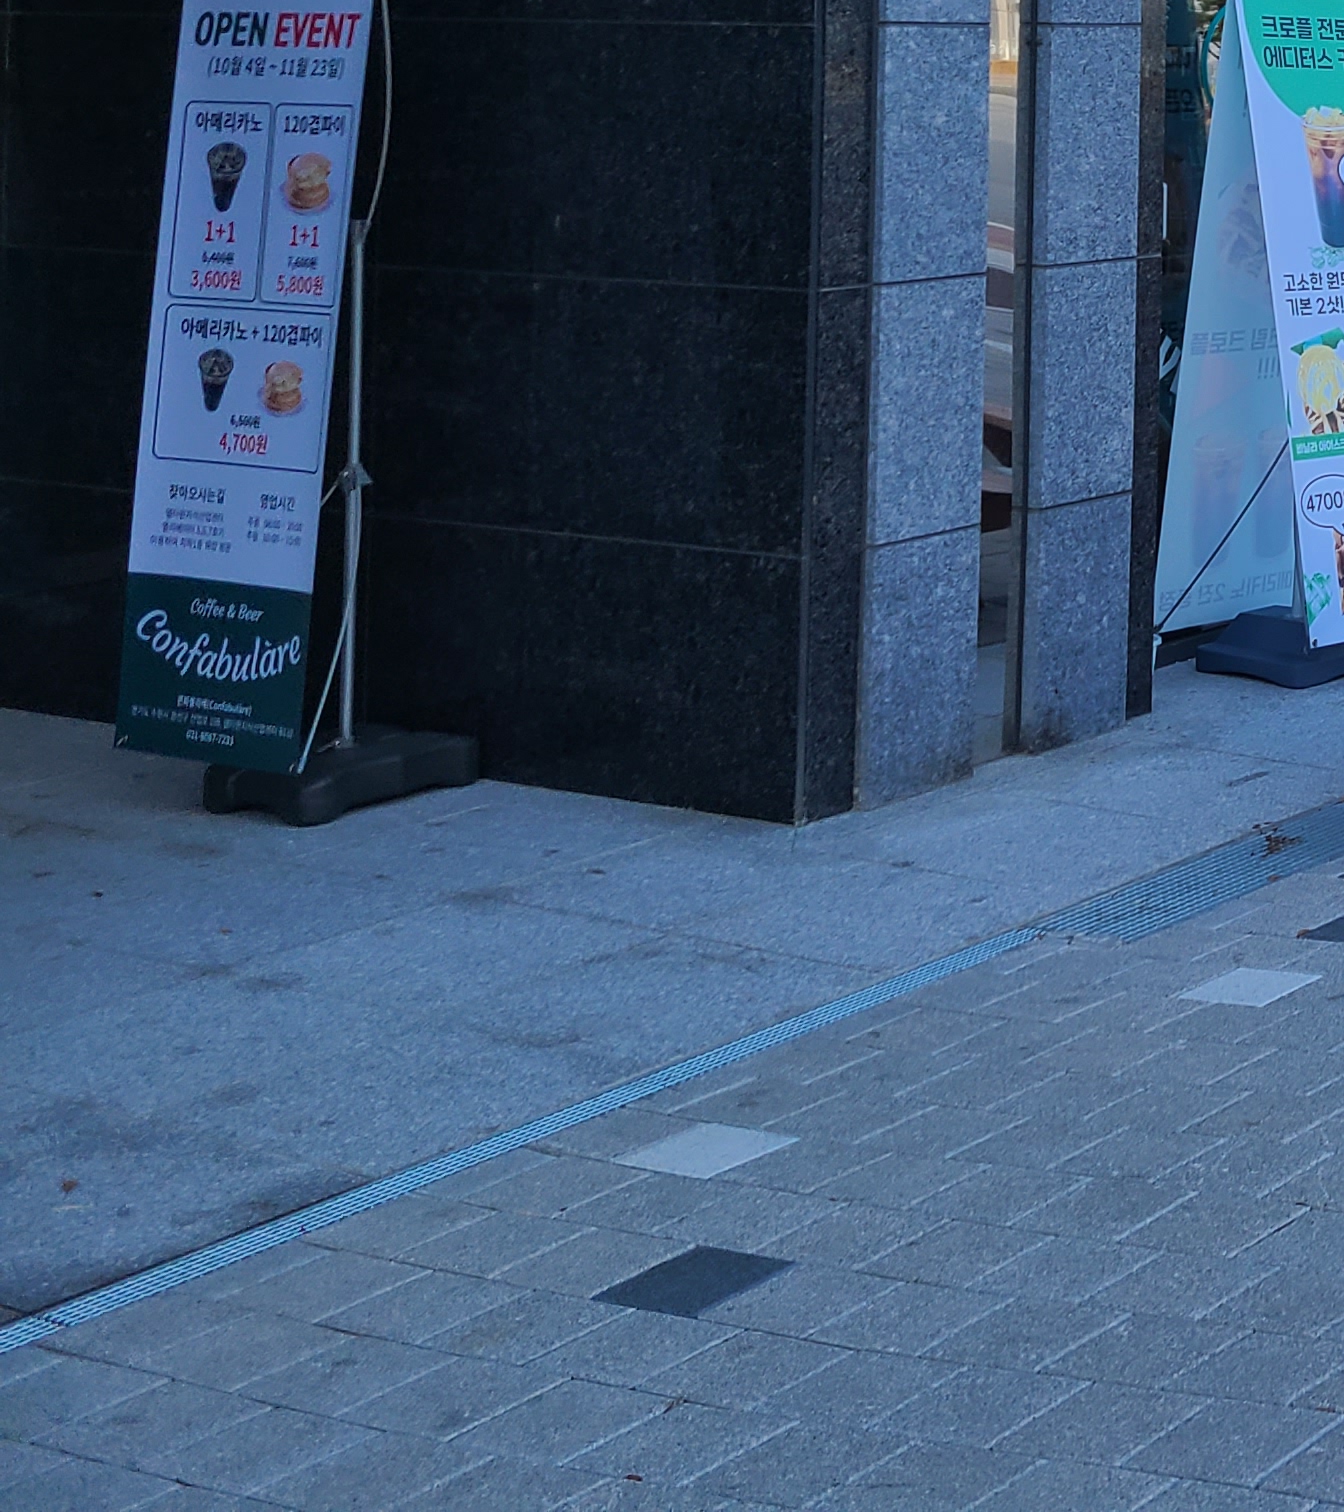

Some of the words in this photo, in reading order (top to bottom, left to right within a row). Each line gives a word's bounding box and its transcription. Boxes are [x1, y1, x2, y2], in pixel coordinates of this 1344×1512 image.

[195, 11, 269, 47] OPEN
[274, 12, 362, 49] EVENT
[1261, 15, 1313, 39] 크로플
[1263, 47, 1334, 70] 에디터스
[196, 111, 264, 134] 아메리카노
[204, 220, 235, 243] 1+1
[289, 225, 319, 248] 1+1
[191, 270, 242, 291] 3,600원
[276, 275, 324, 296] 5,800원
[1283, 272, 1323, 293] 고소한
[1285, 297, 1312, 316] 기본
[181, 318, 248, 341] 아메리카노
[219, 432, 268, 455] 4,700원
[190, 597, 224, 617] Coffee
[227, 603, 236, 617] &
[238, 603, 265, 622] Beer
